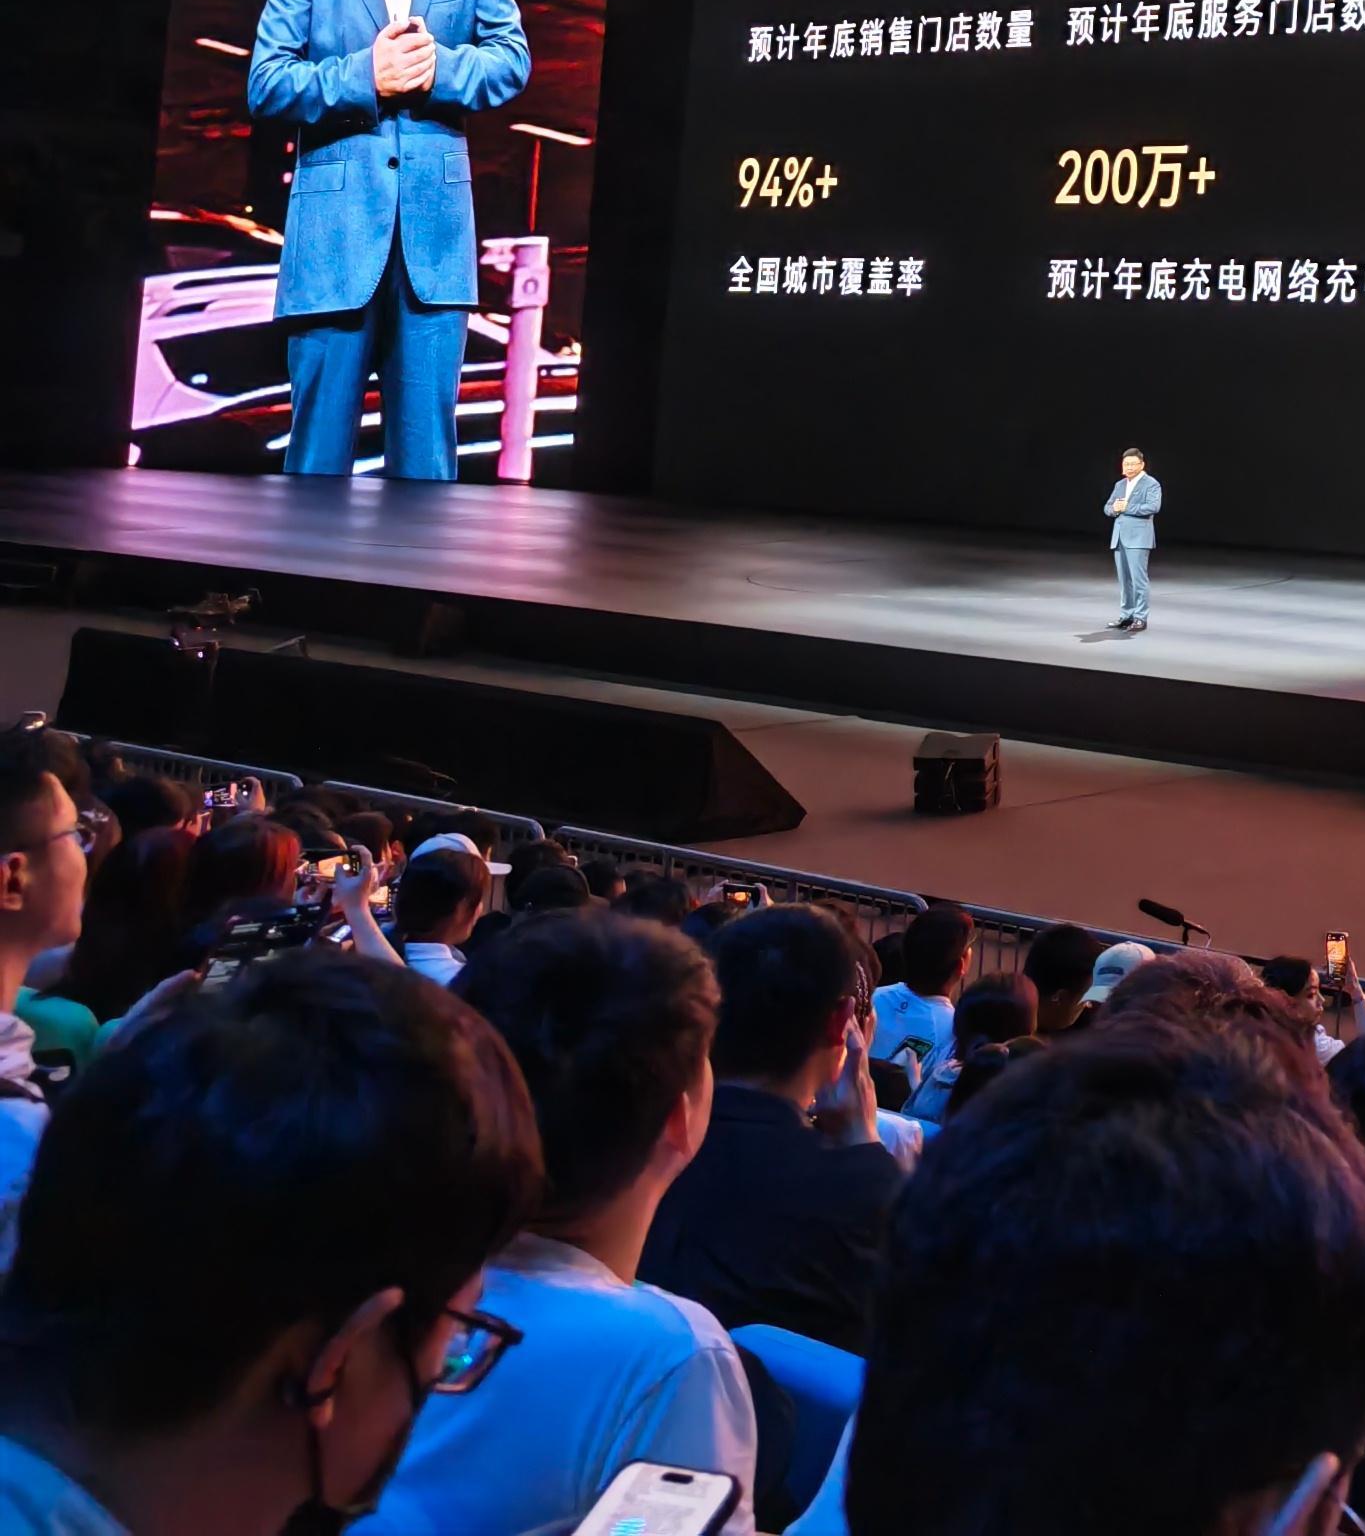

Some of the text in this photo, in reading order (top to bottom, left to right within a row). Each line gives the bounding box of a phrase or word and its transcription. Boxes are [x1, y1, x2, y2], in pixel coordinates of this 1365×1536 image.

[746, 9, 1035, 63] 预计年底销售门店数量
[738, 156, 838, 209] 94%+
[1053, 144, 1216, 209] 200万+
[727, 255, 926, 298] 全国城市覆盖率
